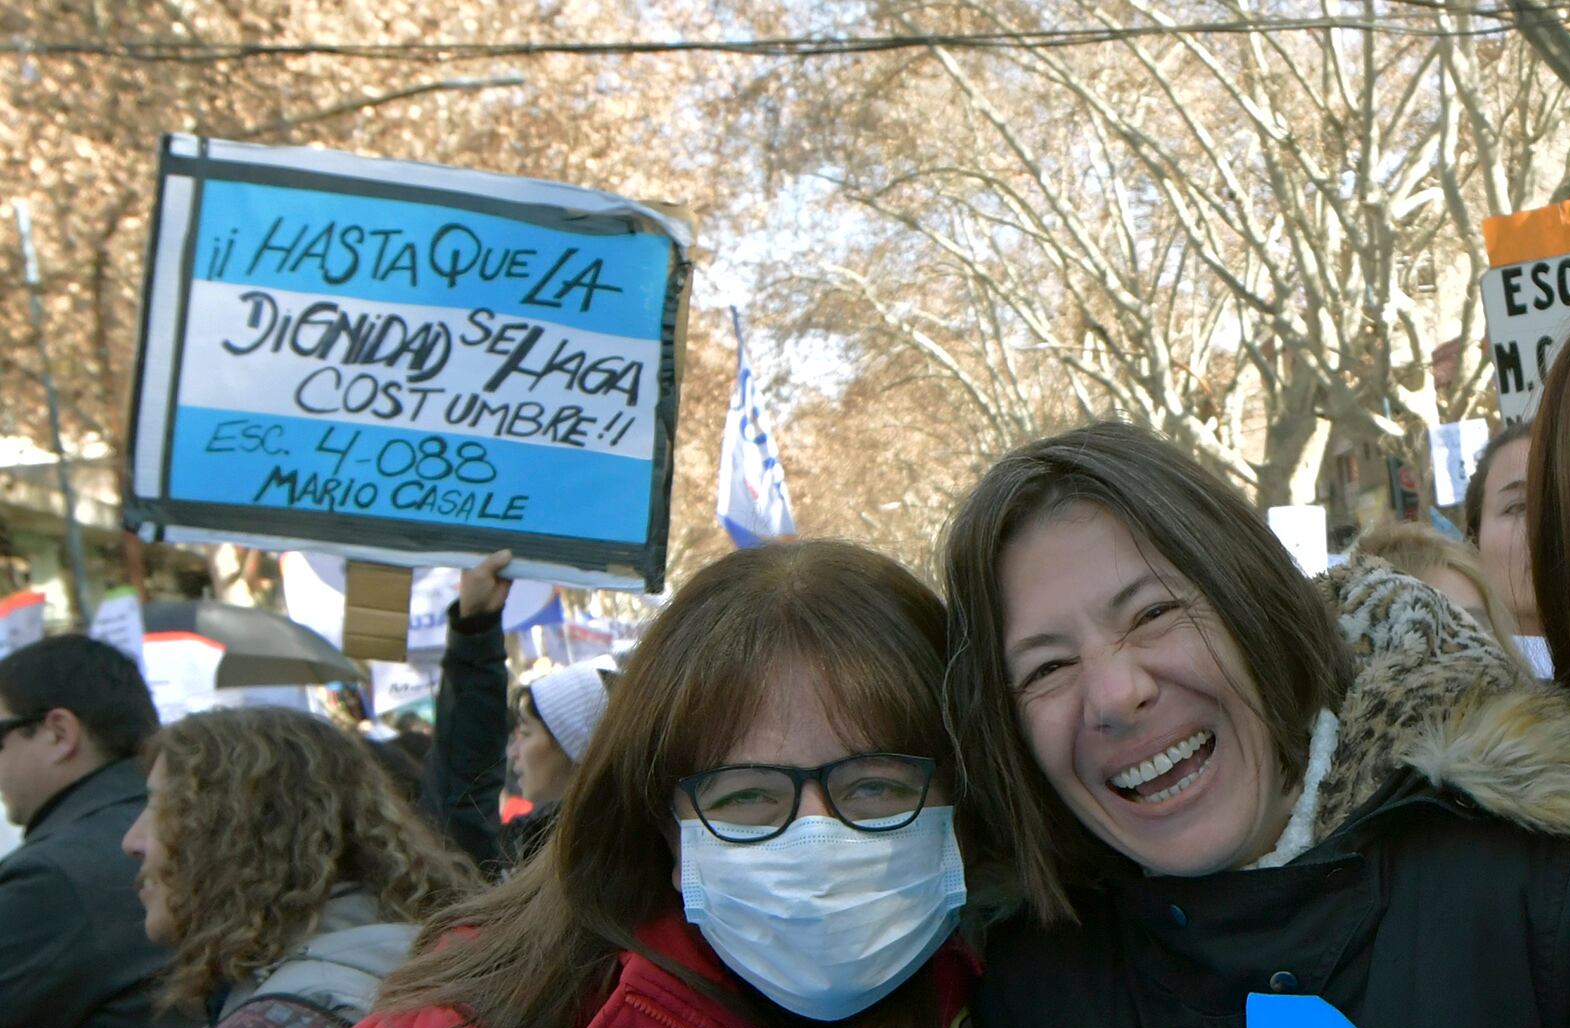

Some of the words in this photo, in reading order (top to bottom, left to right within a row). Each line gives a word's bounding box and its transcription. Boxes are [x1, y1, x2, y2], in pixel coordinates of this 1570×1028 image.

[429, 222, 537, 288] QUE
[519, 247, 624, 312] LA
[459, 307, 529, 356] SE
[482, 325, 644, 407] HAGA
[205, 420, 290, 456] ESC.
[315, 426, 498, 485] 4-088
[253, 465, 379, 514] MARIO
[391, 480, 530, 522] CASALE
